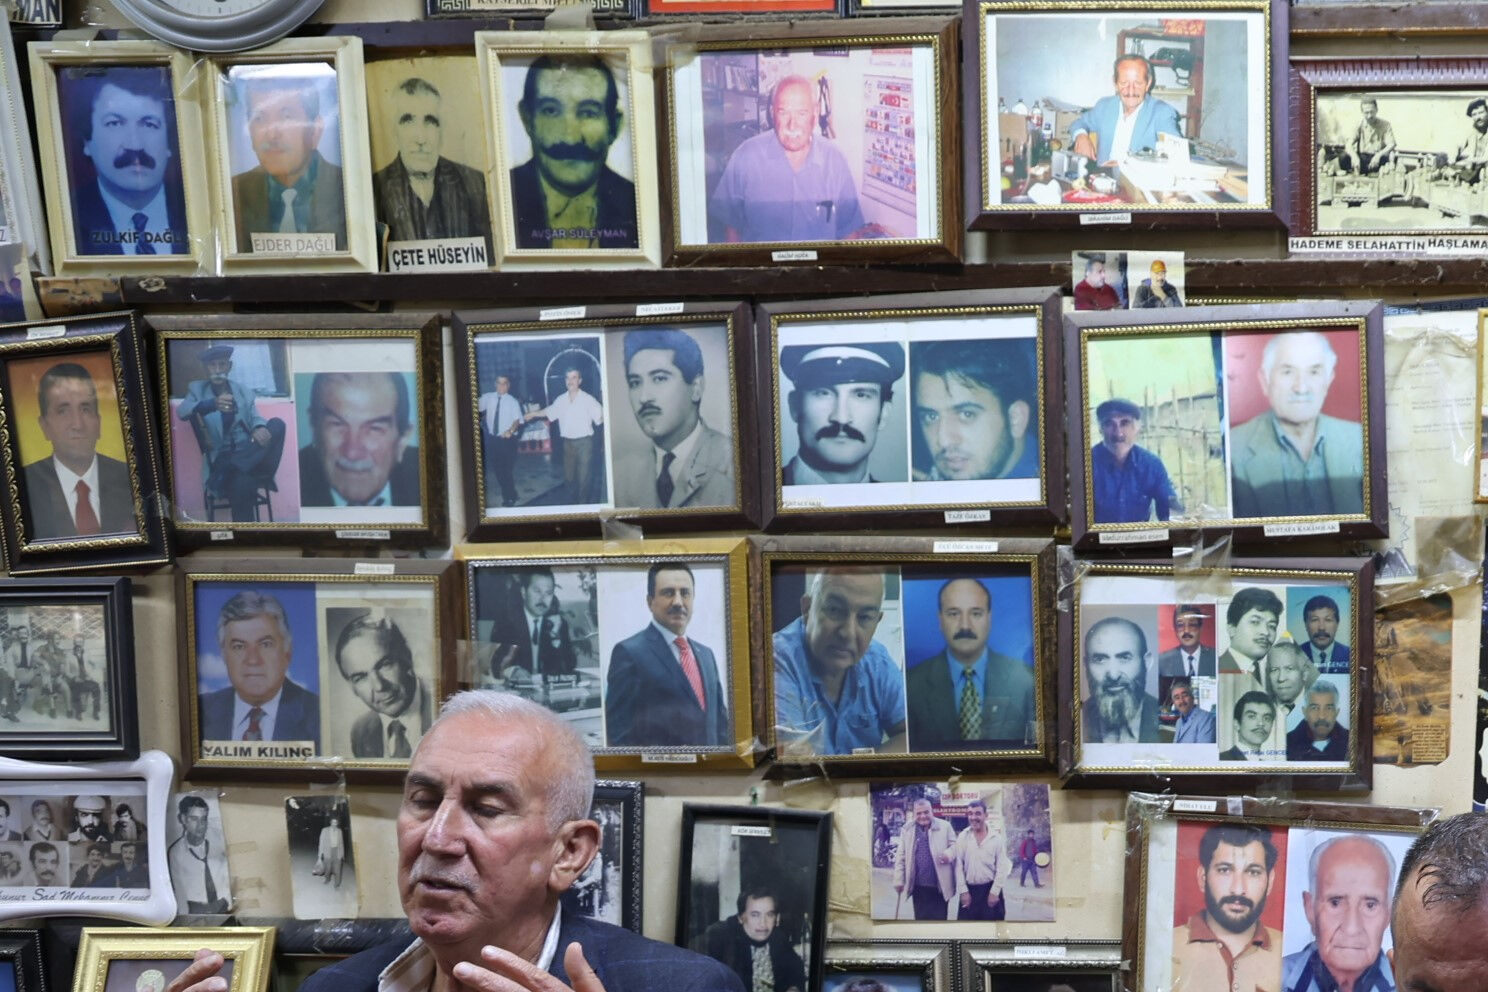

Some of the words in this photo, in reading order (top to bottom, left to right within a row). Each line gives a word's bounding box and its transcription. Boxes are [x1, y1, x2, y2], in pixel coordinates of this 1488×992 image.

[531, 229, 566, 241] AVŞAR
[255, 240, 292, 252] EJDER
[296, 237, 335, 251] DAĞLI
[1290, 239, 1343, 250] HADEME
[1347, 239, 1425, 251] SELAHATTİN
[393, 250, 425, 267] ÇETE
[428, 245, 485, 264] HÜSEYİN
[203, 746, 252, 757] YALIM
